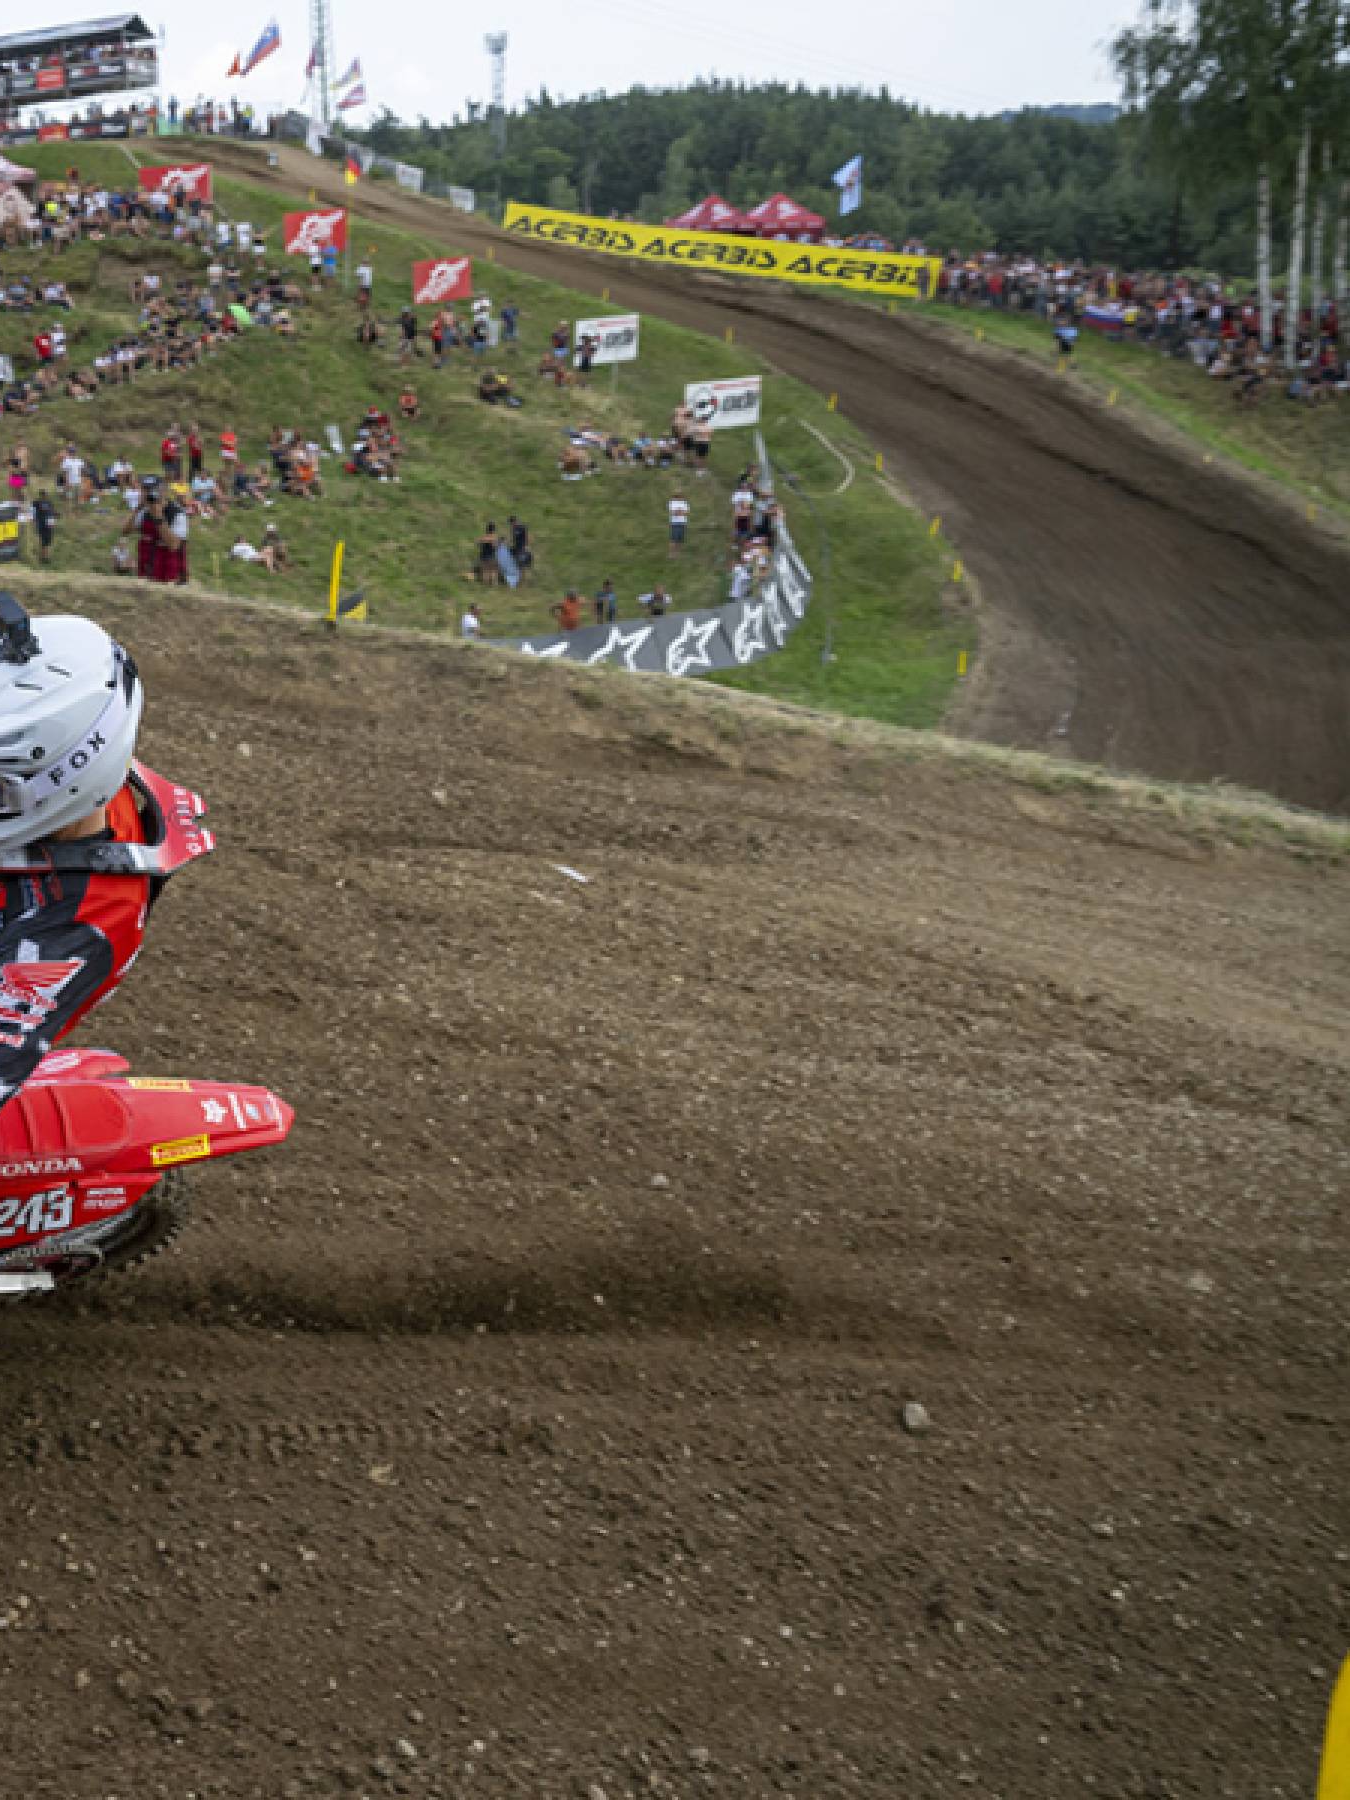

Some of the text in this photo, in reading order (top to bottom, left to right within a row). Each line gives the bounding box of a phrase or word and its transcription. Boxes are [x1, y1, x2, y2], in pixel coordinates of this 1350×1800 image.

[506, 214, 636, 251] ACERBIS
[641, 236, 778, 269] ACERBIS
[47, 730, 107, 787] FOX
